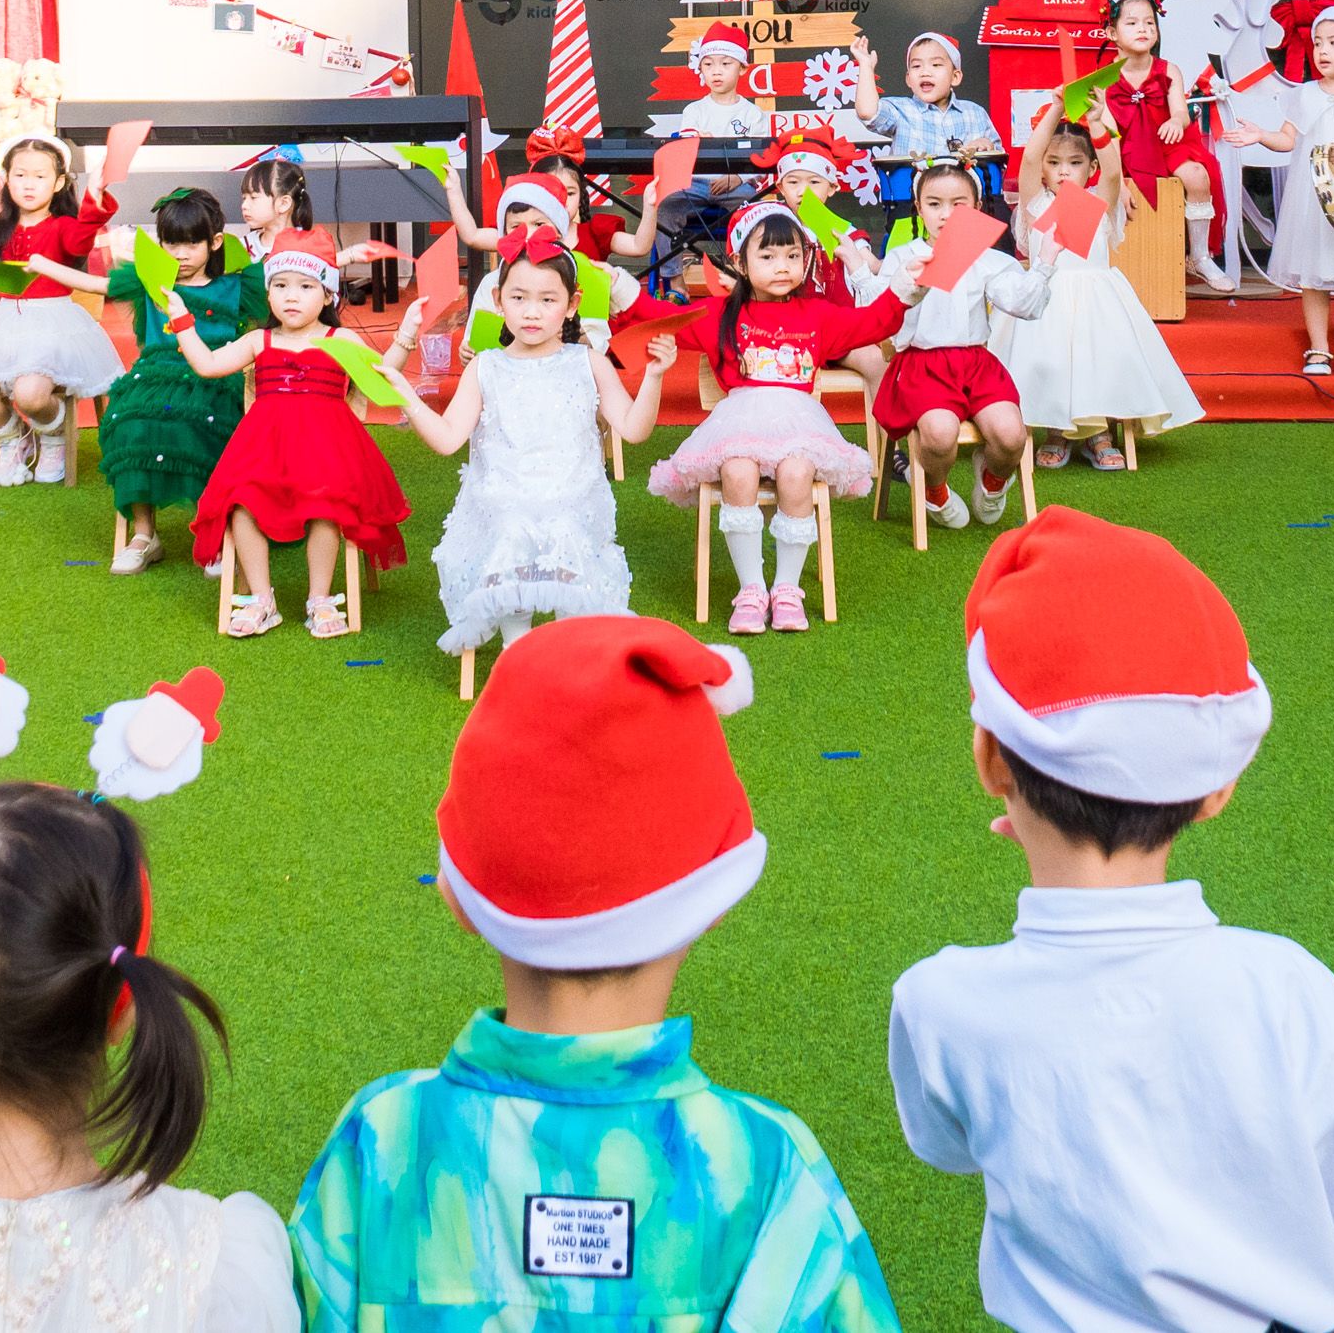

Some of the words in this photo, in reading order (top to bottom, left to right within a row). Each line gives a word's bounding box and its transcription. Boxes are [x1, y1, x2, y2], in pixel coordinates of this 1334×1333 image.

[748, 63, 777, 95] a
[770, 113, 835, 138] RRY
[577, 1209, 613, 1220] STUDIOS
[553, 1221, 574, 1232] ONE
[577, 1223, 605, 1234] TIMES
[547, 1235, 577, 1247] HAND
[579, 1237, 611, 1248] MADE
[554, 1251, 603, 1265] EST.1987
